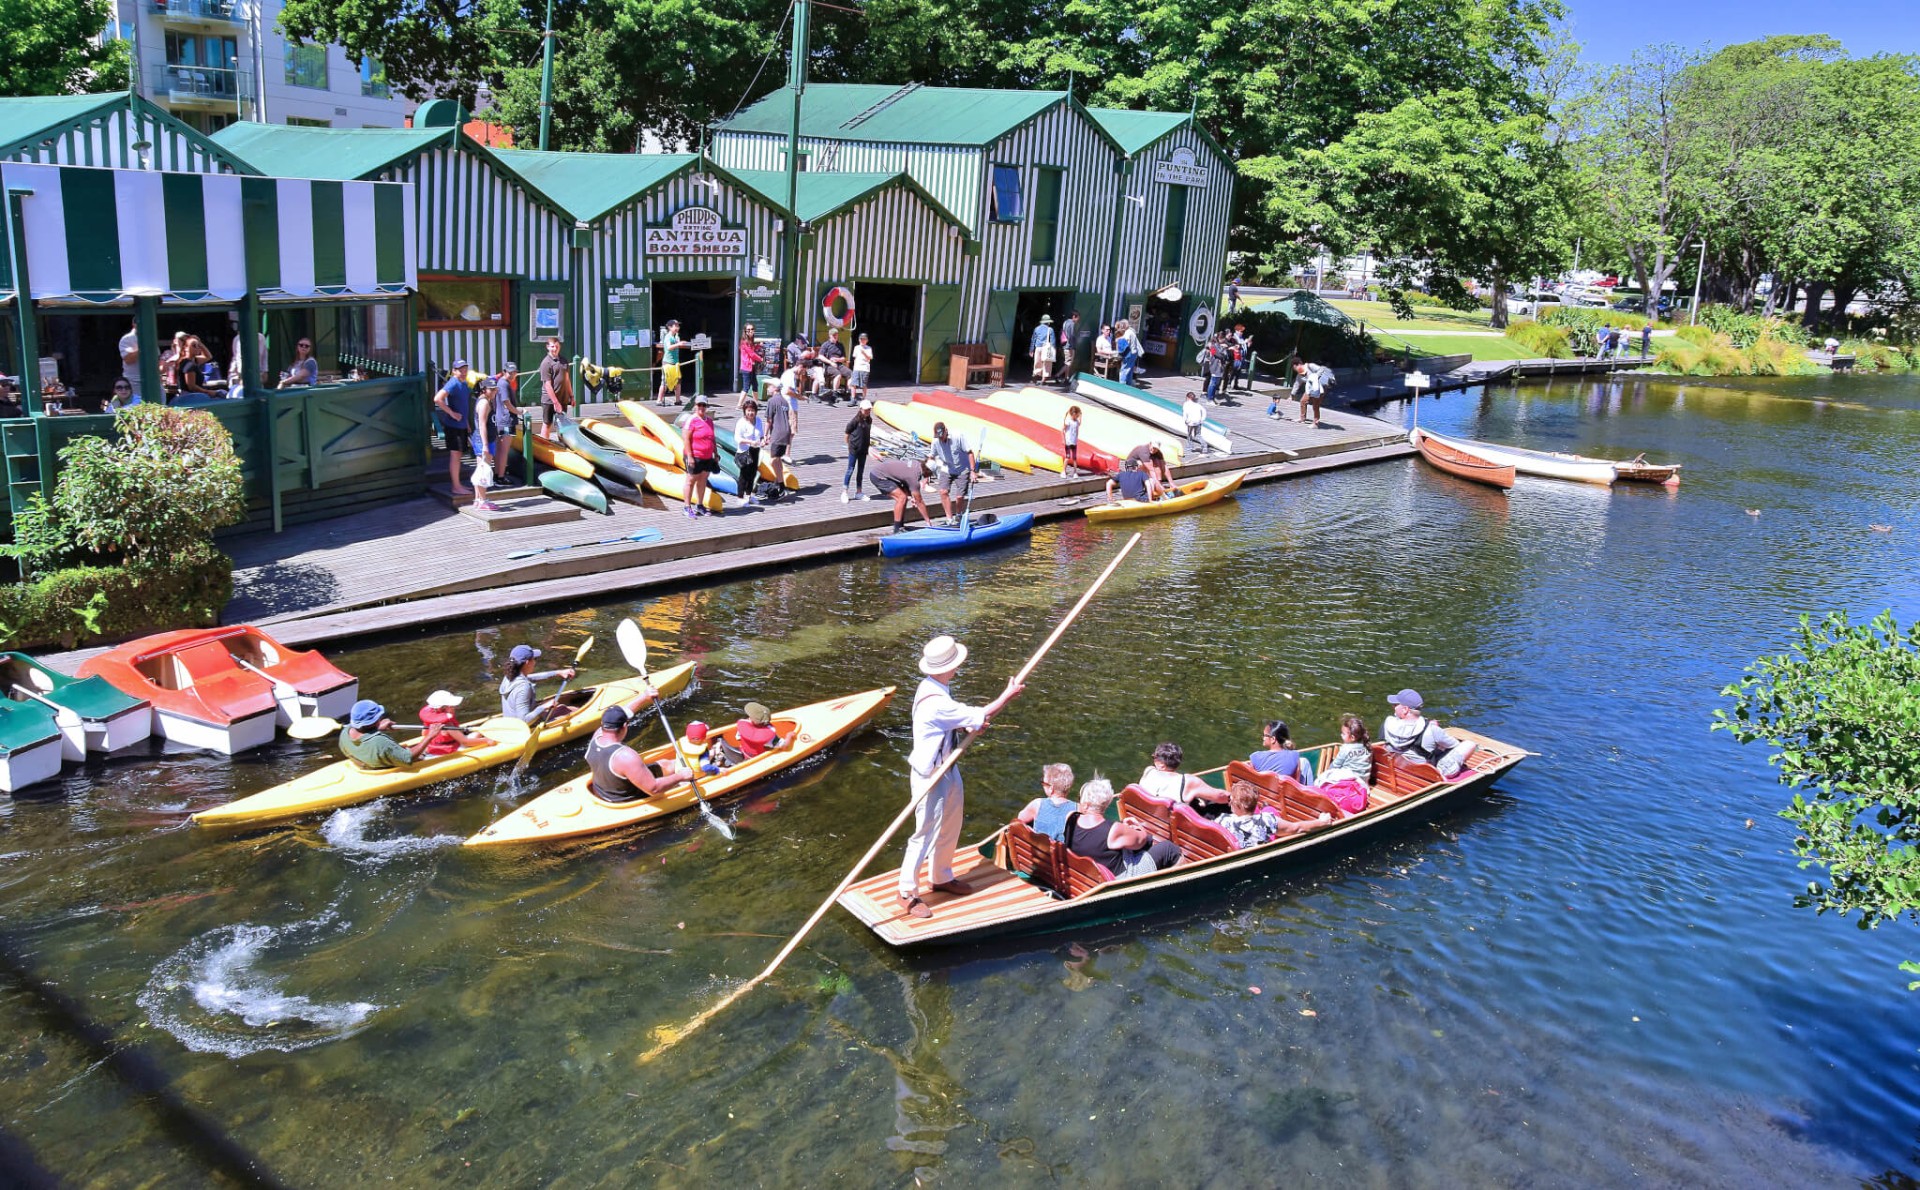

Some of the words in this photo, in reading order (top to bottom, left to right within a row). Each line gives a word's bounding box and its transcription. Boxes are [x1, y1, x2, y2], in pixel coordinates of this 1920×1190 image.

[1158, 162, 1207, 176] PUNTING
[1157, 172, 1166, 180] IN
[1168, 173, 1183, 182] THE
[1185, 175, 1205, 186] PARK
[677, 208, 718, 225] PHIPPS
[648, 230, 744, 243] ANTIGUA
[649, 243, 688, 253] BOAT
[692, 243, 741, 254] SHEDS
